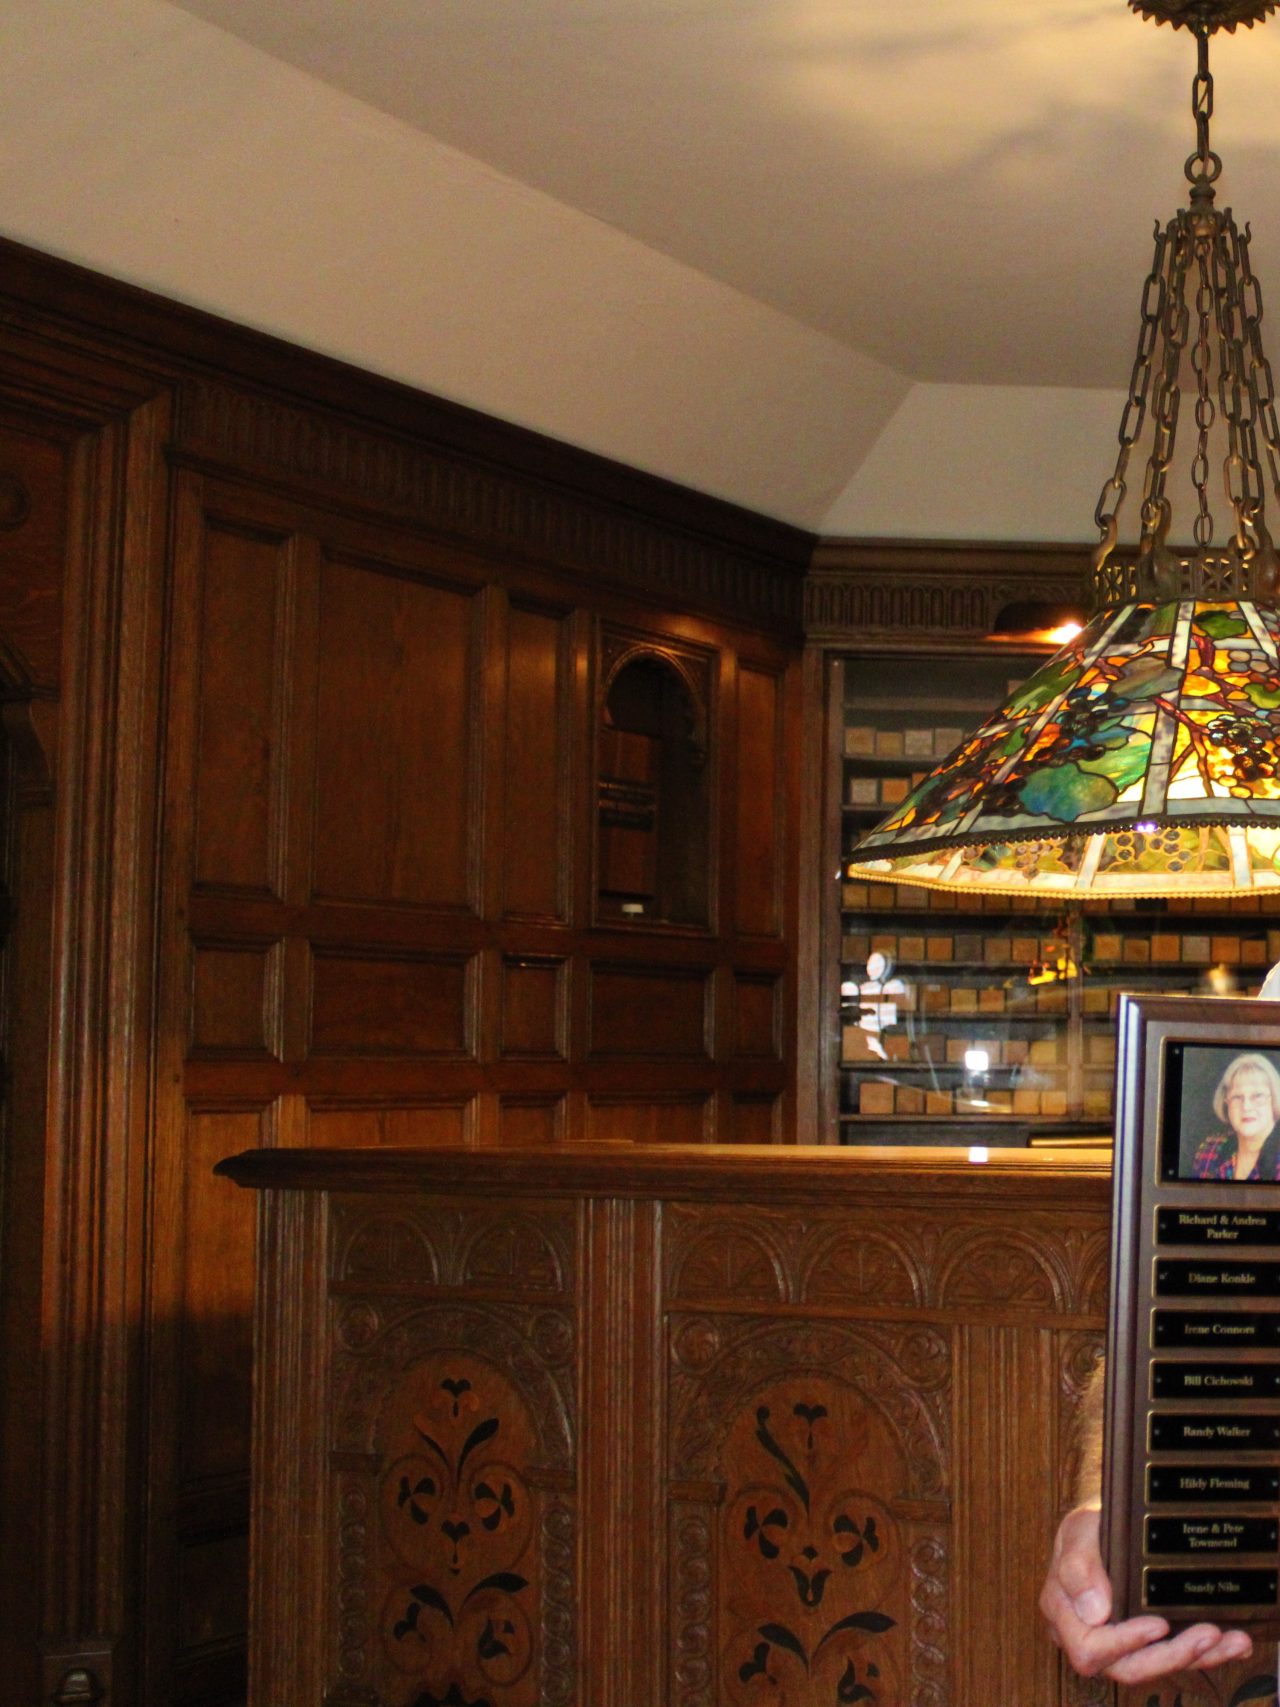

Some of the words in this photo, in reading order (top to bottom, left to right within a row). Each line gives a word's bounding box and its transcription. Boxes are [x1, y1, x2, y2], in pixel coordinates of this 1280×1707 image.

[1179, 1214, 1217, 1225] Richard
[1219, 1215, 1229, 1225] &
[1231, 1215, 1267, 1226] Andrea
[1207, 1228, 1239, 1239] Parker
[1188, 1273, 1218, 1283] Diane
[1184, 1324, 1210, 1334] Irene
[1212, 1324, 1255, 1334] Connors
[1184, 1375, 1202, 1386] Bill
[1183, 1426, 1215, 1438] Randy
[1216, 1426, 1251, 1437] Walker
[1209, 1478, 1250, 1490] Fleming
[1183, 1523, 1209, 1534] Irene
[1211, 1524, 1220, 1534] &
[1188, 1537, 1238, 1548] Townsend
